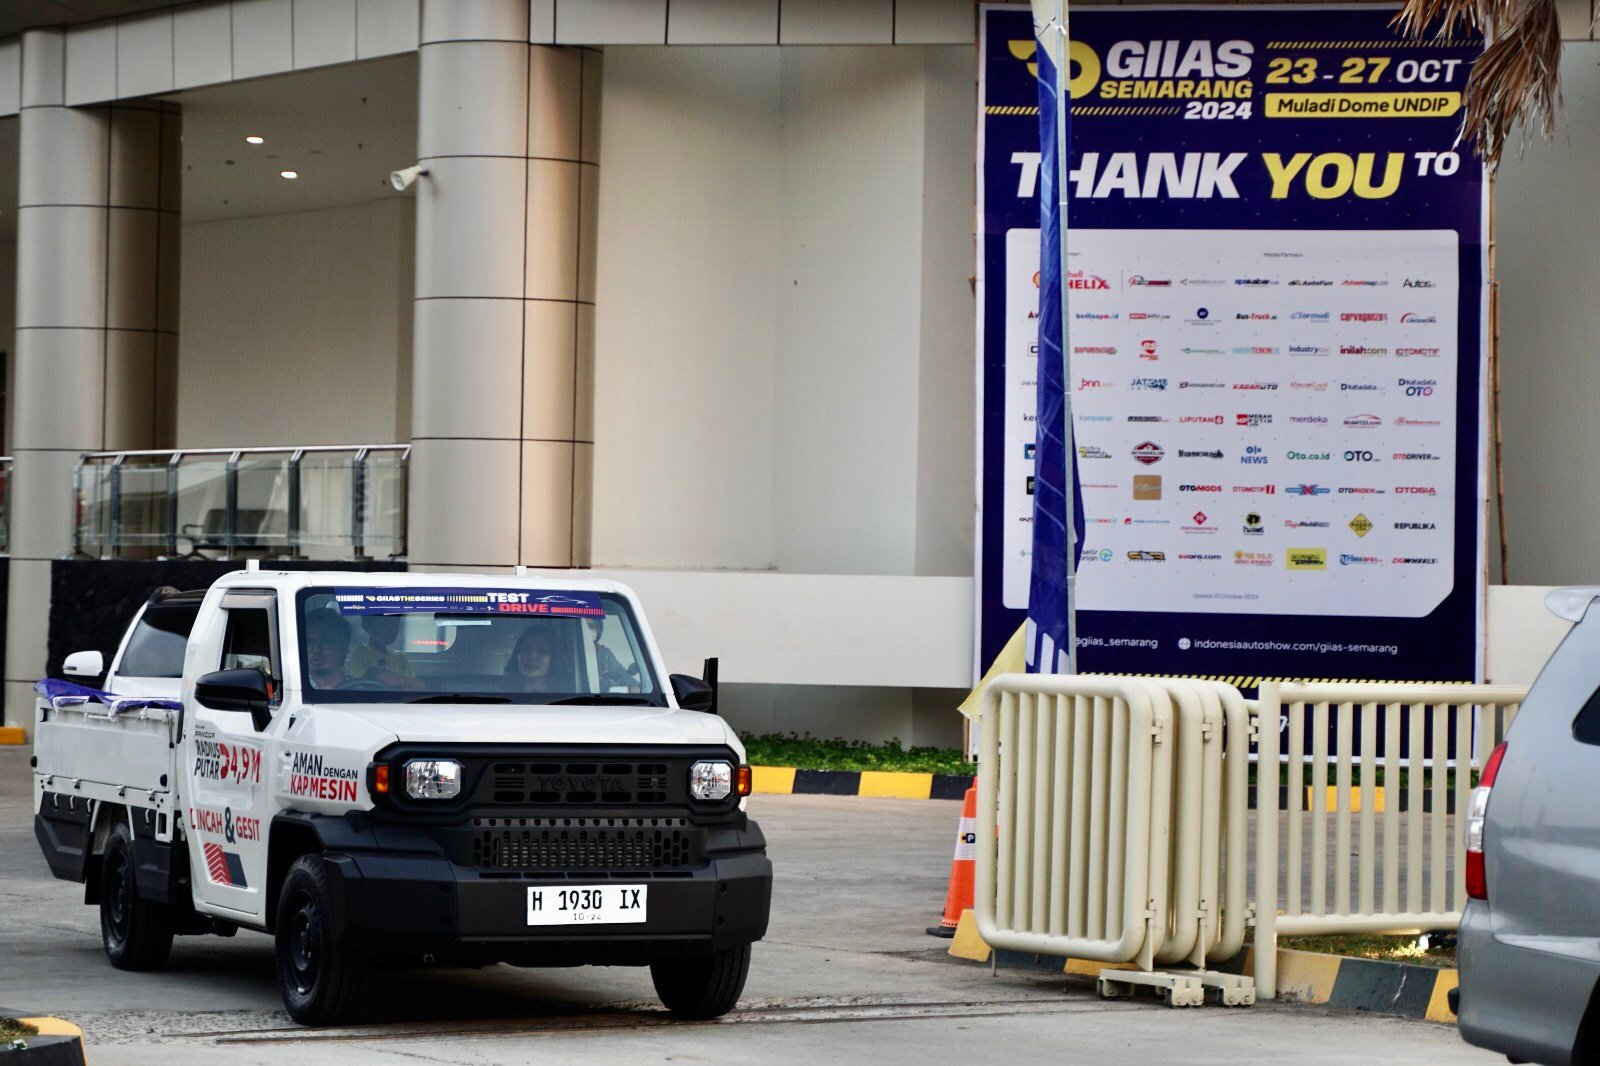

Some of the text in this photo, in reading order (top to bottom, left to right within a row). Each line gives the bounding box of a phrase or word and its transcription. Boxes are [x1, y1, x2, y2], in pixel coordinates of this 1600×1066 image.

[1106, 40, 1254, 78] GIIAS
[1265, 57, 1317, 84] 23
[1339, 57, 1391, 84] 27
[1396, 58, 1462, 83] OCT
[1100, 80, 1253, 99] SEMARANG
[1184, 101, 1252, 120] 2024
[1278, 97, 1450, 113] Muladi Dome UNDIP
[1010, 151, 1461, 199] THANK YOU TO
[1406, 386, 1433, 396] OTO
[1289, 415, 1328, 423] merdeka
[1241, 456, 1269, 464] NEWS
[1287, 450, 1330, 460] Oto.co.id
[1394, 522, 1436, 530] REPUBLIKA
[487, 592, 529, 603] TEST
[498, 603, 549, 613] DRIVE
[1194, 639, 1398, 655] indonesiaautoshow.com/giias-semarang
[195, 740, 221, 759] RADIUS
[194, 758, 220, 780] PUTAR
[293, 752, 358, 779] AMAN DENGAN
[310, 779, 358, 801] MESIN
[538, 776, 624, 791] TOYOTA
[225, 807, 236, 844] &
[236, 816, 260, 841] GESIT
[532, 889, 640, 911] H 1930 IX
